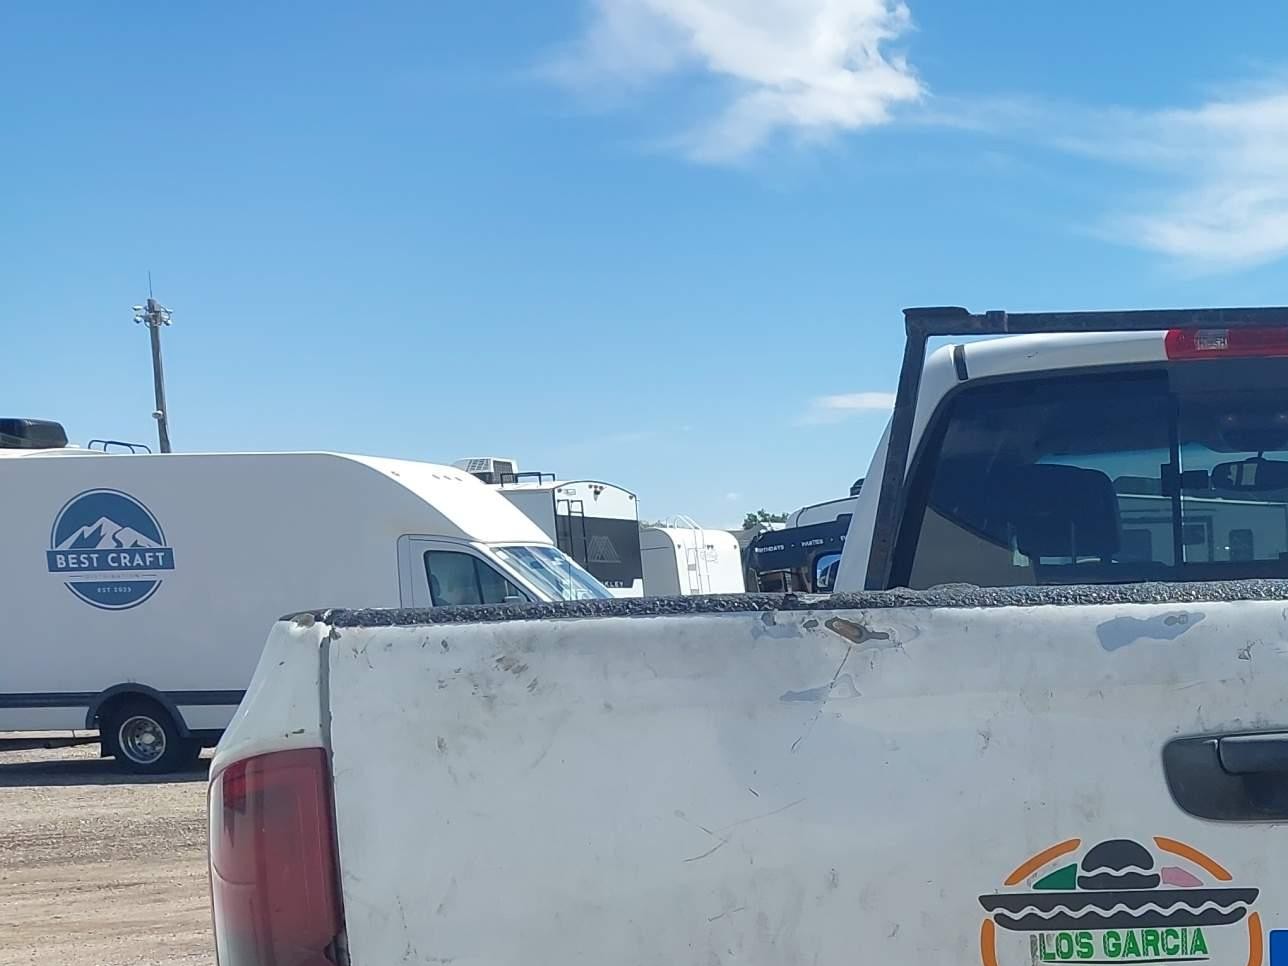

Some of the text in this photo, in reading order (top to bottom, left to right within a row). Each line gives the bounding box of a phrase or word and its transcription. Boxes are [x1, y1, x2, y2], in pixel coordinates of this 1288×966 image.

[56, 552, 165, 568] BEST CRAFT
[1038, 927, 1209, 961] LOS GARCIA
